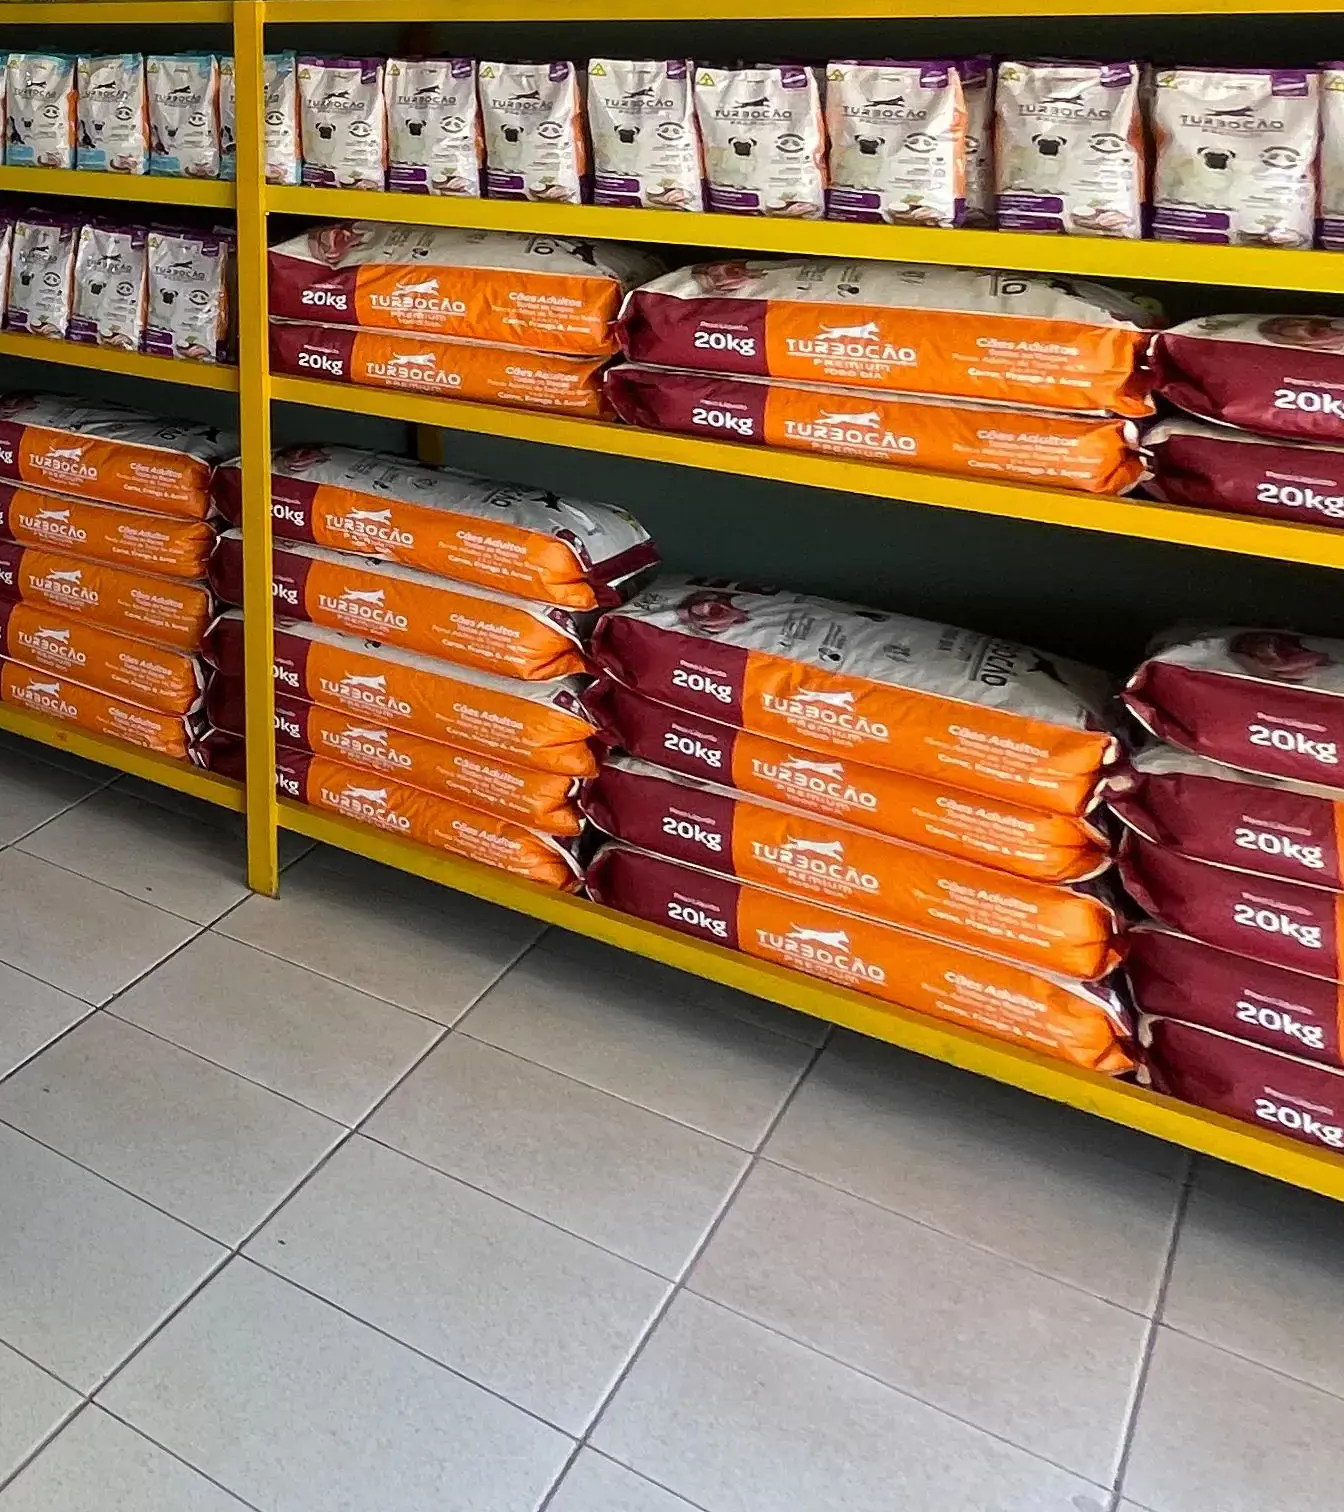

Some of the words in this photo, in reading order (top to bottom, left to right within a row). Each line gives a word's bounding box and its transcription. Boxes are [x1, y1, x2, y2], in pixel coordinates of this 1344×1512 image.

[301, 290, 347, 311] 20kg
[693, 331, 756, 356] 20kg
[786, 338, 917, 361] TURBOCÃO
[298, 352, 343, 376] 20kg
[692, 407, 754, 436] 20kg
[1273, 389, 1344, 419] 20k
[785, 421, 916, 452] TURBOCÃO
[1256, 483, 1344, 518] 20kg
[672, 669, 732, 704] 20kg
[664, 732, 721, 768] 20kg
[1248, 723, 1338, 764] 20kg
[662, 817, 721, 852] 20kg
[1235, 827, 1325, 869] 20kg
[667, 902, 728, 938] 20kg
[1234, 902, 1322, 949] 20kg
[1236, 1000, 1324, 1050] 20kg
[1255, 1098, 1344, 1148] 20kg
